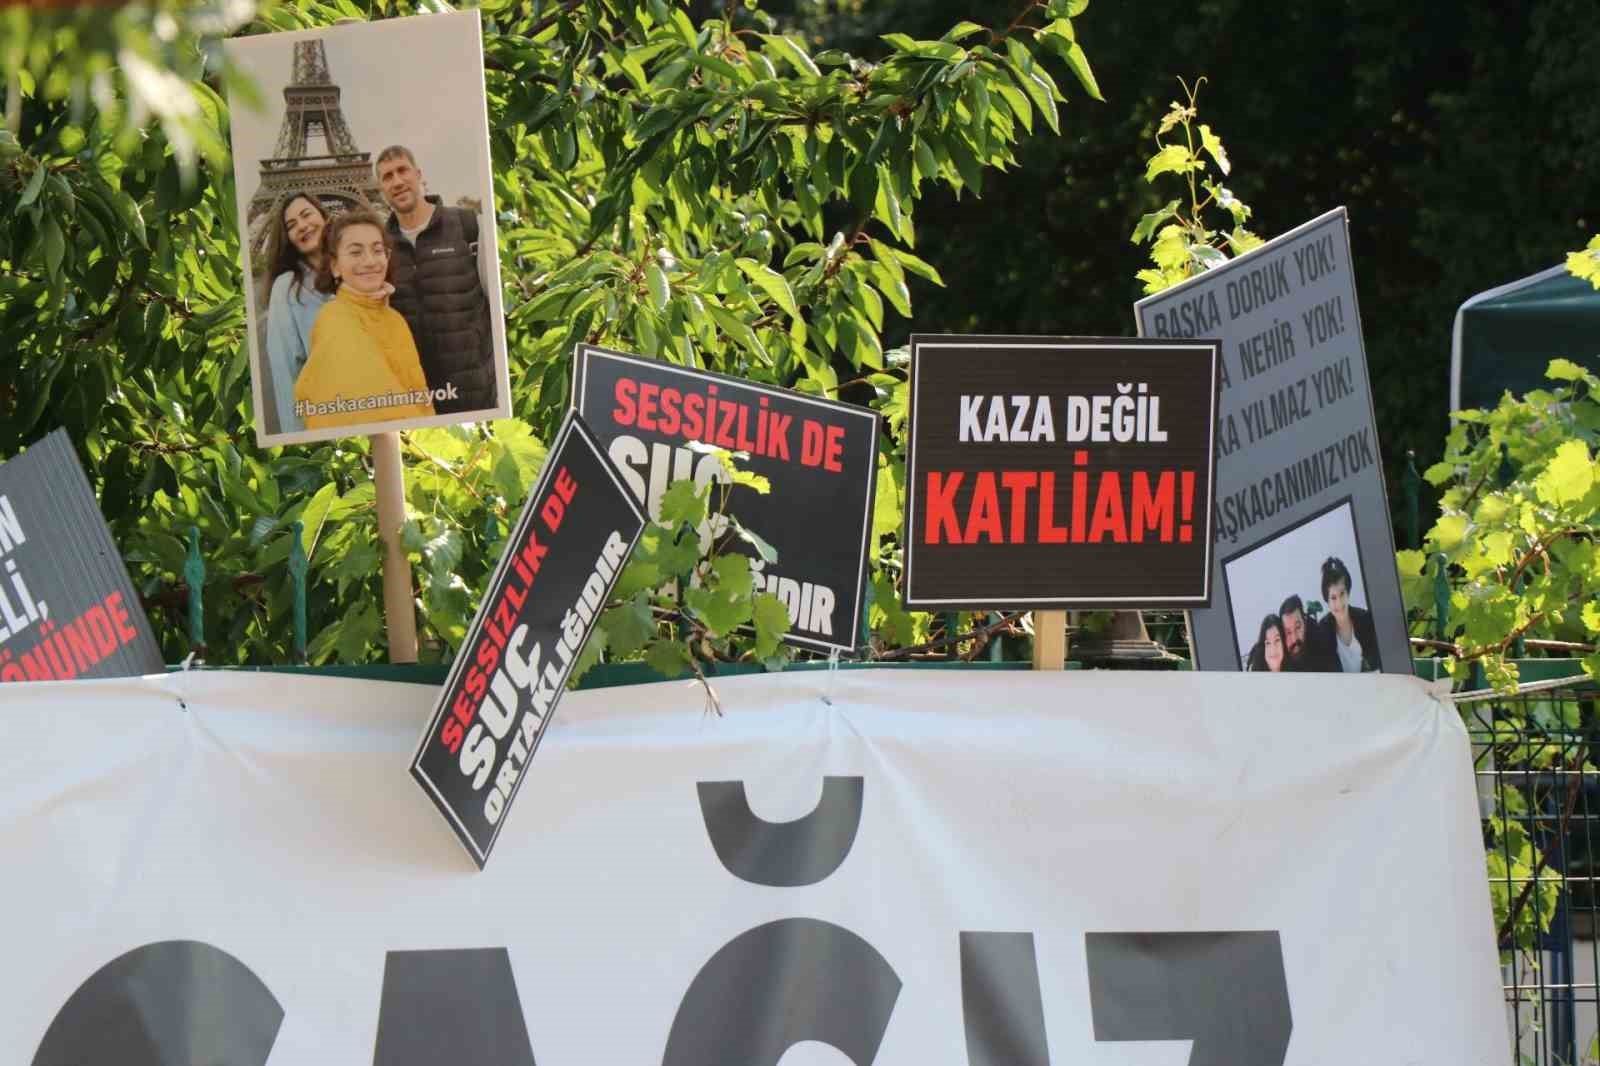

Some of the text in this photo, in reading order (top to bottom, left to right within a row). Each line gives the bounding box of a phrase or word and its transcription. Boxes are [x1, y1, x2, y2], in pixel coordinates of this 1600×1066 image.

[1226, 258, 1291, 321] DORUK
[1294, 234, 1337, 287] YOK!
[1238, 318, 1296, 381] NEHİR
[1302, 296, 1345, 350] YOK!
[294, 382, 459, 416] #baskacanimizyok
[612, 376, 846, 474] SESSİZLİK DE
[959, 395, 1056, 442] KAZA
[1066, 382, 1168, 442] DEĞİL
[1241, 378, 1311, 445] YILMAZ
[1312, 356, 1355, 410] YOK!
[924, 450, 1196, 544] KATLİAM!
[1215, 427, 1374, 544] AŞKACANIMIZYOK
[441, 465, 579, 754] SESSİZLİK DE
[459, 623, 541, 791] SUÇ
[484, 529, 630, 826] ORTAKLIĞIDIR
